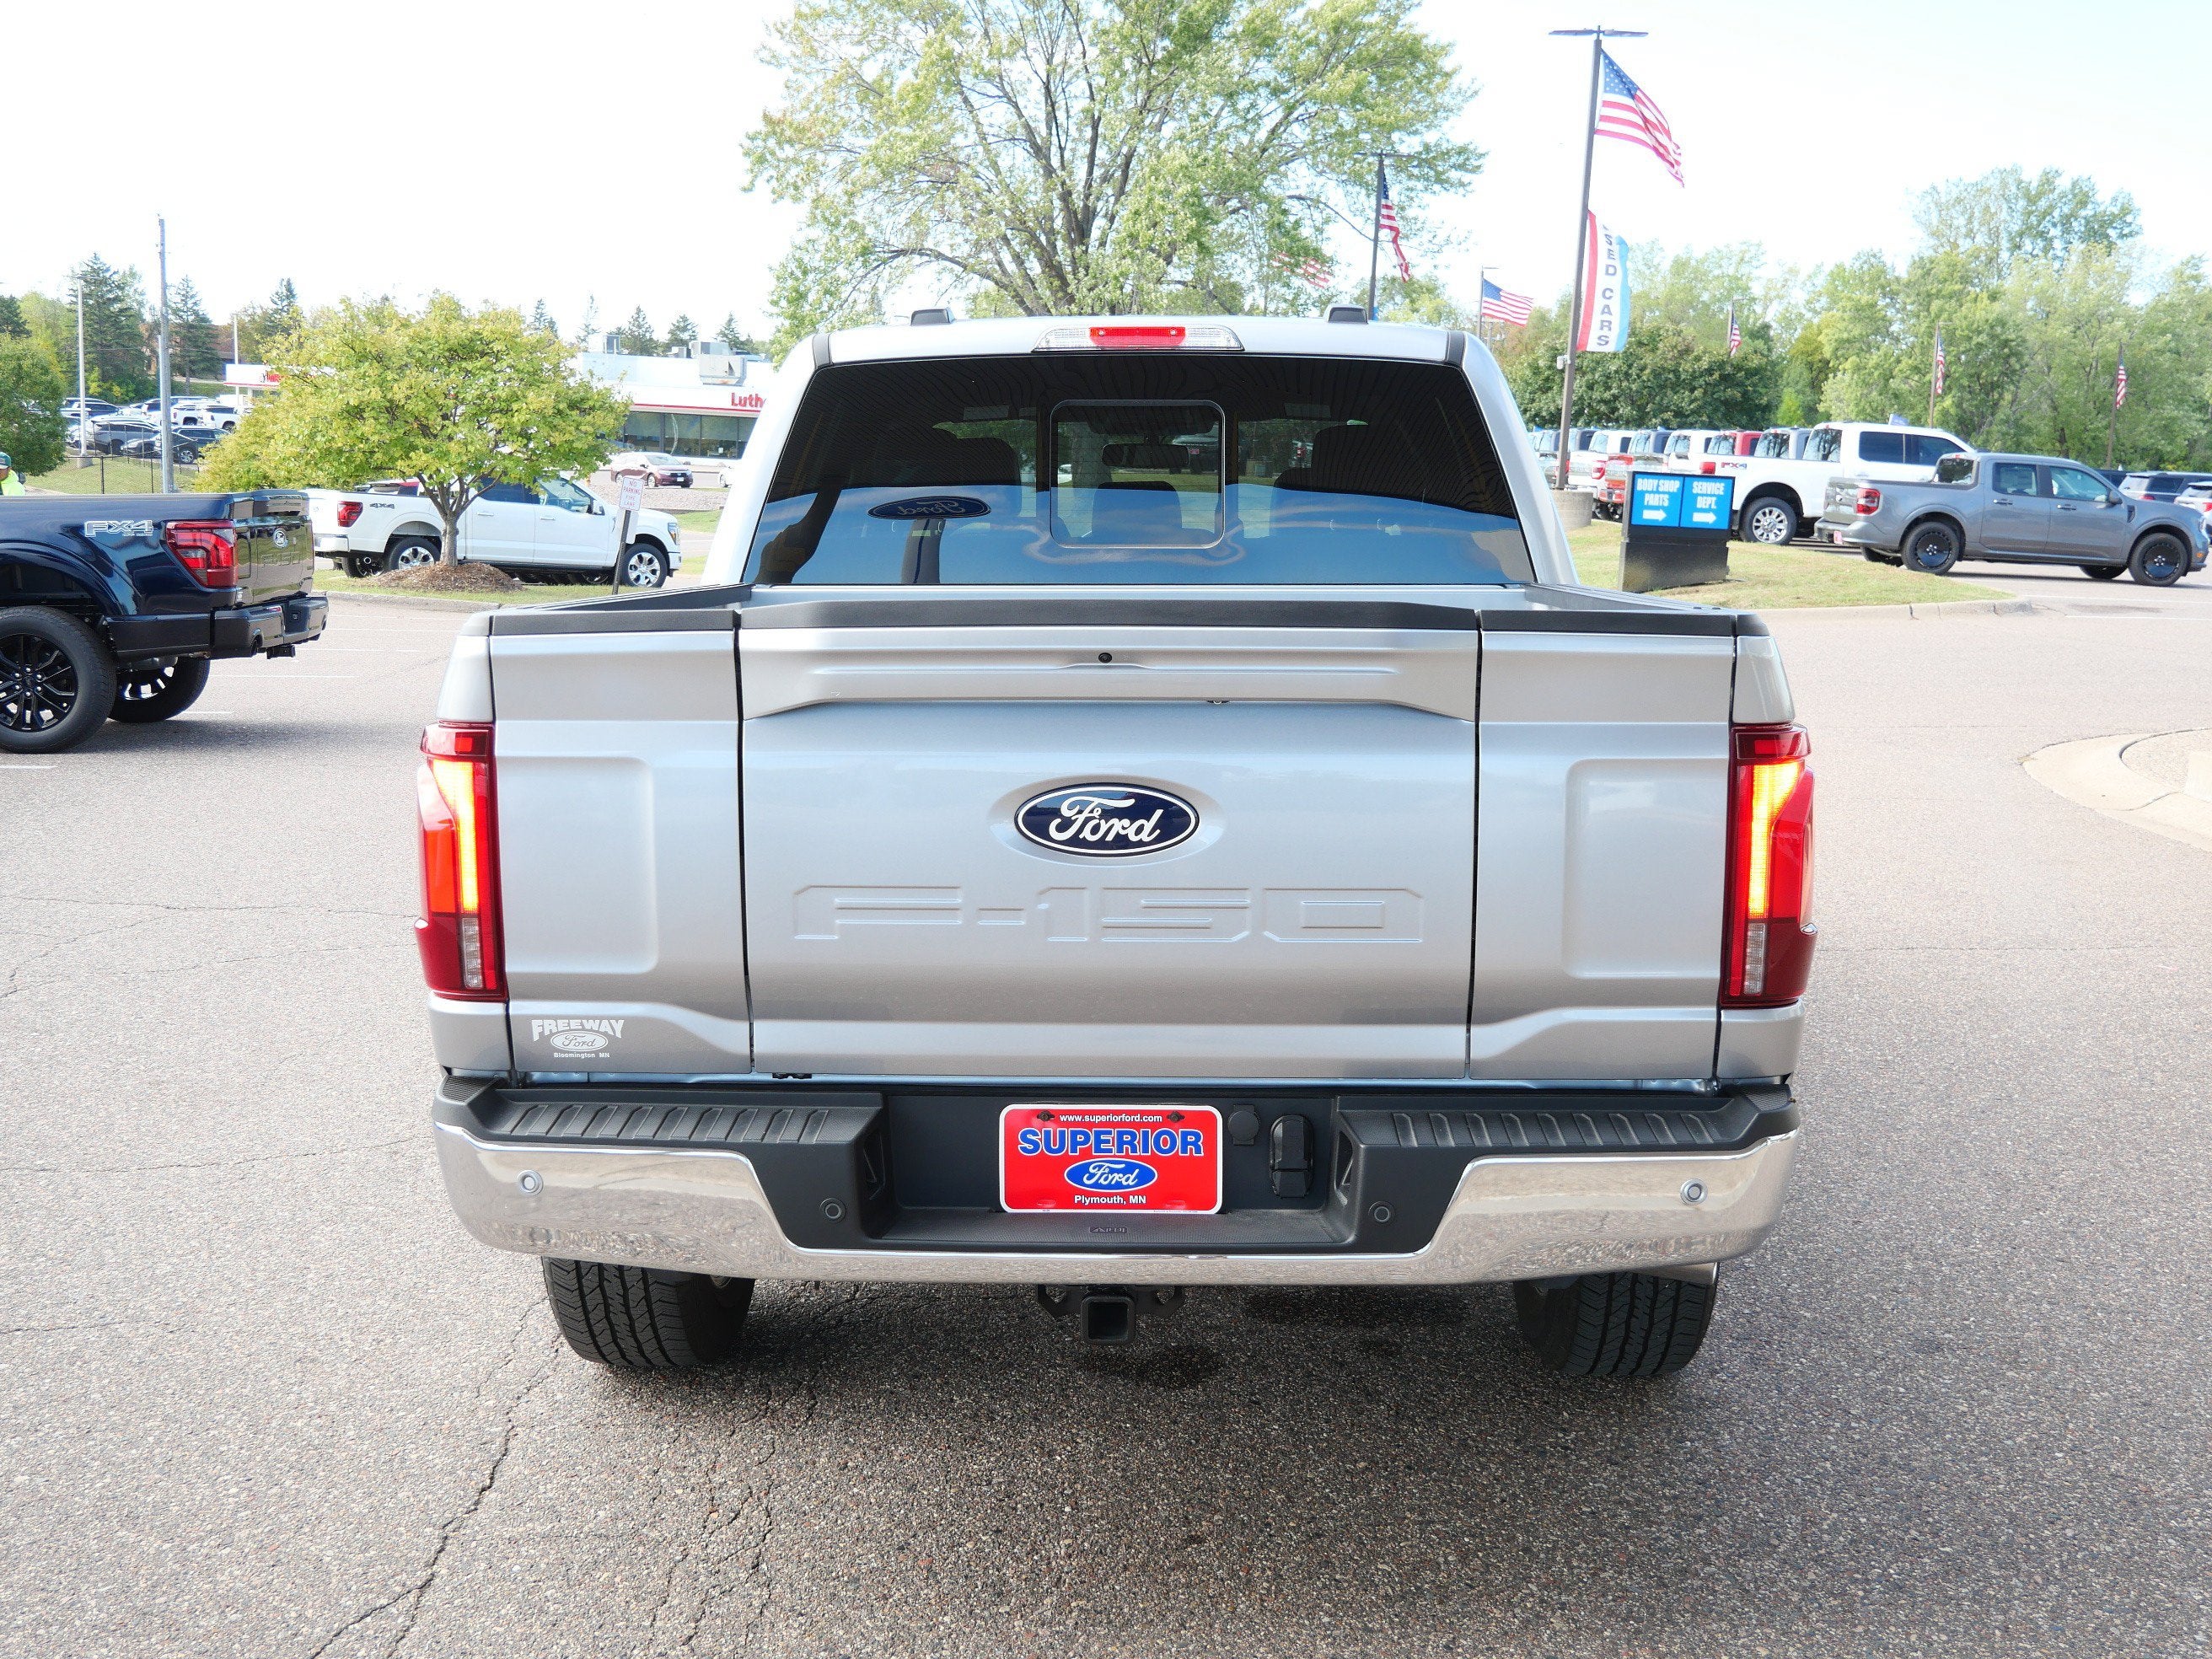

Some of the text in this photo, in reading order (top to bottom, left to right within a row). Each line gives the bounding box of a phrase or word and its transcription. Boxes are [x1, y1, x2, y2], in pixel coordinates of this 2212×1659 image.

[1597, 224, 1617, 346] SED CARS
[1636, 478, 1680, 493] BODY SHOP
[1692, 481, 1725, 495] SERVICE
[1644, 493, 1669, 507] PARTS
[1696, 497, 1717, 509] DEPT.
[84, 519, 153, 538] FX4
[1049, 796, 1165, 842] Ford
[793, 885, 1423, 942] F-150
[531, 1019, 625, 1042] FREEWAY
[561, 1034, 597, 1048] Ford
[1059, 1113, 1163, 1124] www.superiorford.com
[1017, 1127, 1204, 1157] SUPERIOR
[1082, 1162, 1140, 1187] Ford
[1074, 1195, 1147, 1206] Plymouth, MN
